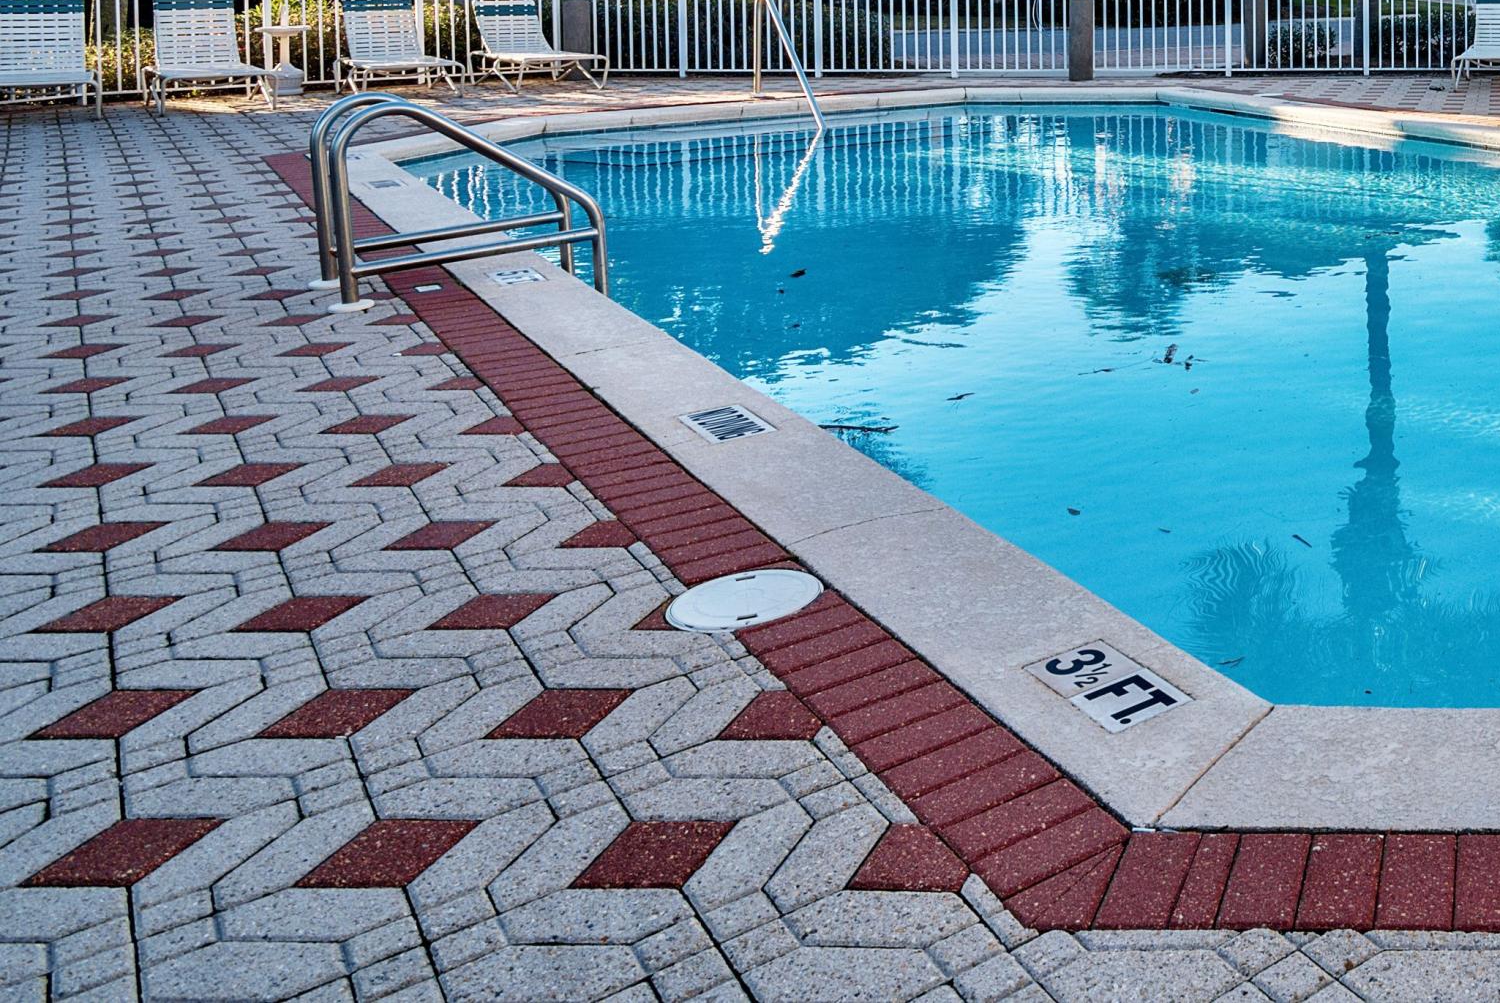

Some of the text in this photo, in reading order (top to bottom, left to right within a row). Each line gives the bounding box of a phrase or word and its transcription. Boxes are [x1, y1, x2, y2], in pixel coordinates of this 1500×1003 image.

[687, 406, 766, 441] NO DIVING
[1084, 674, 1178, 725] FT.
